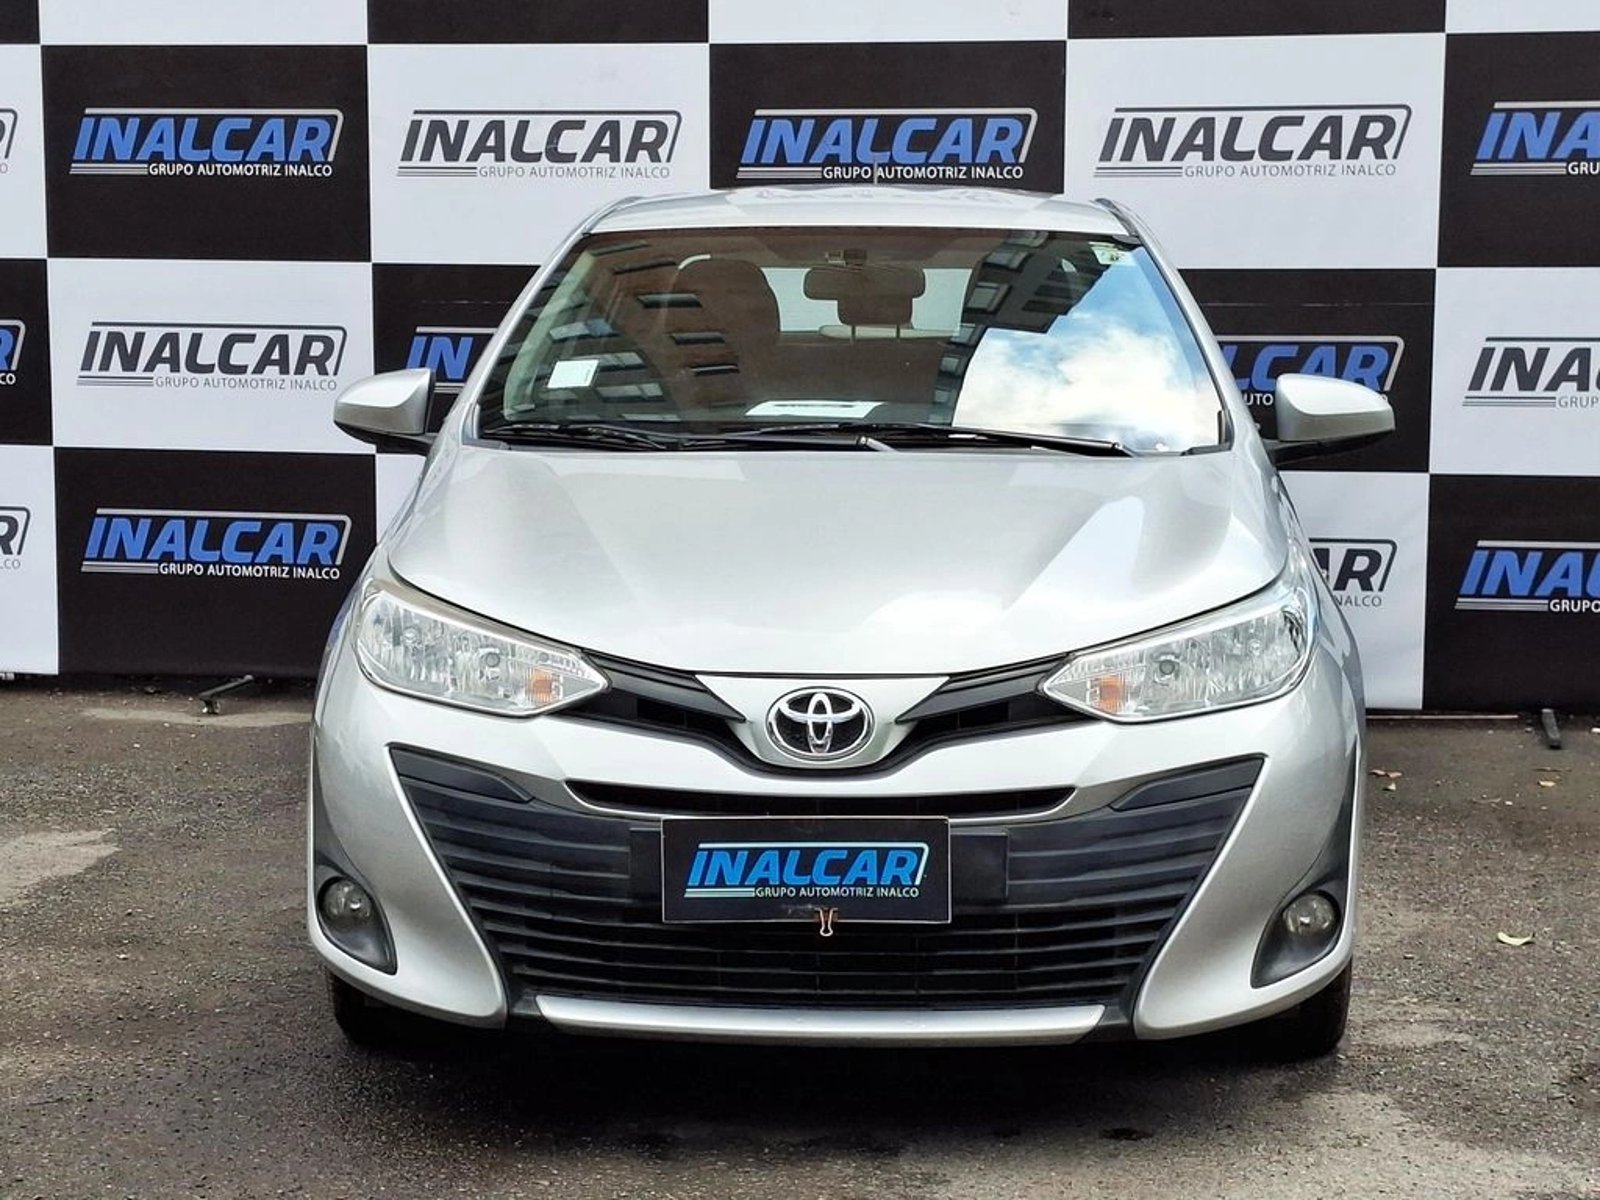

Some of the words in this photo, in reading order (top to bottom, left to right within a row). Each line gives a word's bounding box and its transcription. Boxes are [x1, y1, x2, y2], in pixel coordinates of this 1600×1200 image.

[74, 117, 331, 162] INALCAR
[400, 119, 669, 164] INALCAR
[742, 118, 1023, 165] INALCAR
[1099, 115, 1396, 162] INALCAR
[149, 163, 194, 176] GRUPO
[197, 163, 281, 177] AUTOMOTRIZ
[285, 164, 333, 177] INALCO
[479, 166, 525, 178] GRUPO
[529, 166, 616, 179] AUTOMOTRIZ
[621, 166, 670, 179] INALCO
[823, 166, 871, 179] GRUPO
[876, 166, 967, 179] AUTOMOTRIZ
[971, 166, 1024, 179] INALCO
[1185, 164, 1235, 178] GRUPO
[1240, 164, 1336, 177] AUTOMOTRIZ
[1341, 163, 1396, 176] INALCO
[80, 330, 335, 376] INALCAR
[155, 376, 199, 388] GRUPO
[203, 377, 286, 389] AUTOMOTRIZ
[290, 378, 337, 391] INALCO
[86, 517, 339, 565] INALCAR
[159, 563, 204, 575] GRUPO
[207, 564, 290, 578] AUTOMOTRIZ
[293, 566, 340, 580] INALCO
[687, 849, 919, 887] INALCAR
[755, 887, 796, 898] GRUPO
[799, 887, 873, 898] AUTOMOTRIZ
[876, 887, 919, 898] INALCO
